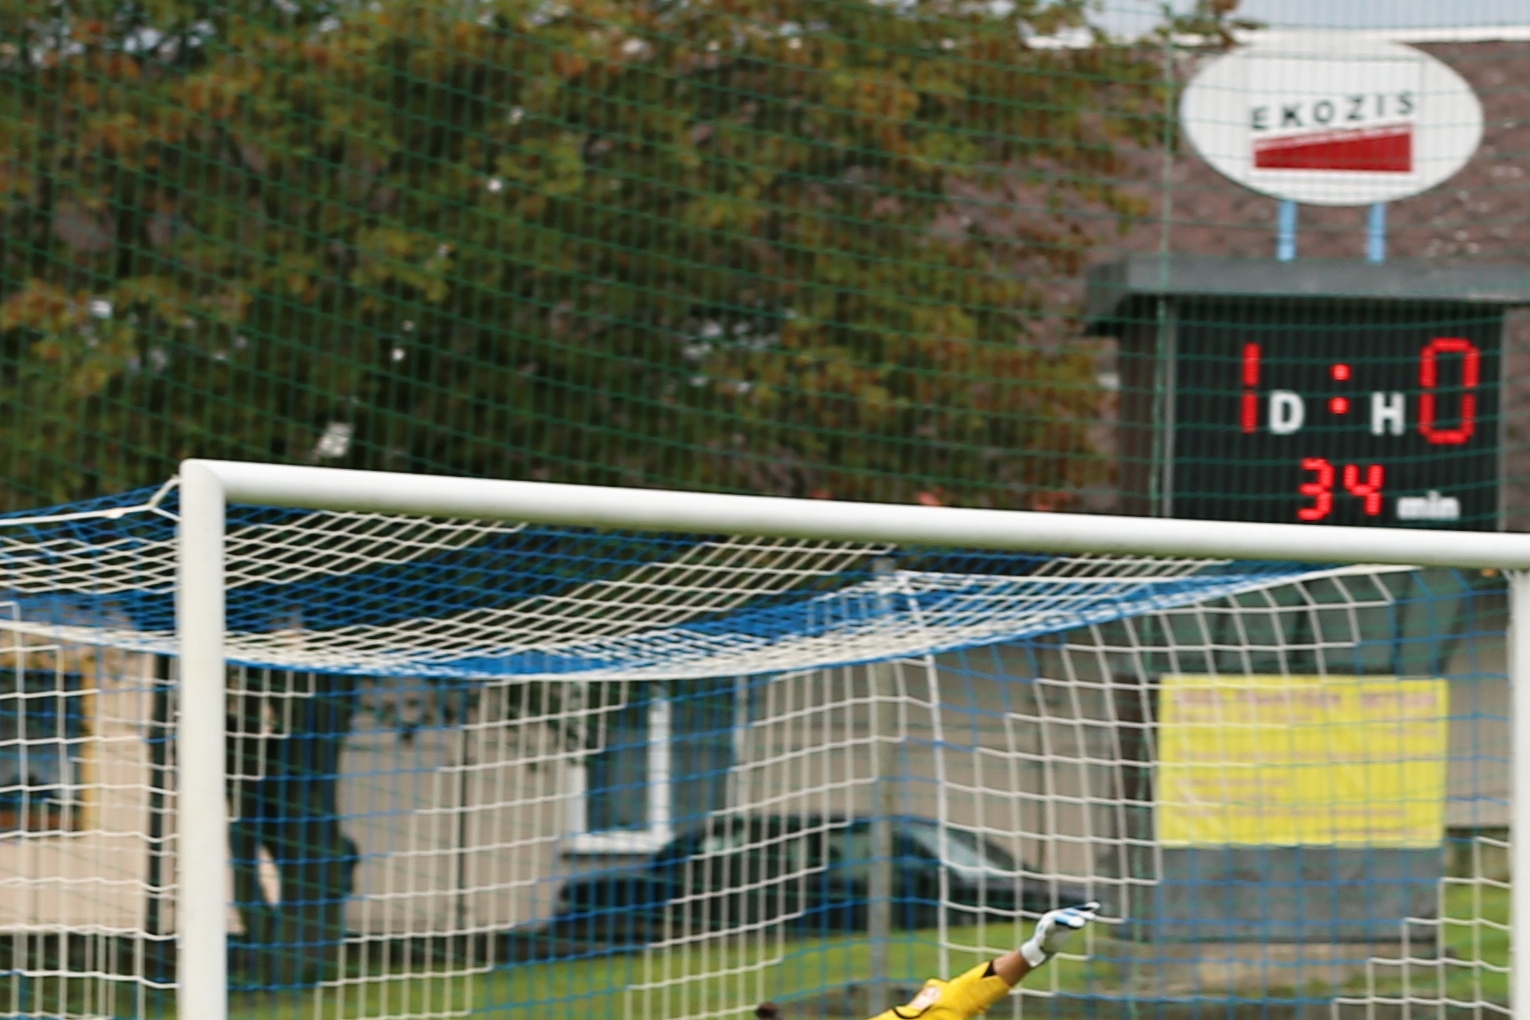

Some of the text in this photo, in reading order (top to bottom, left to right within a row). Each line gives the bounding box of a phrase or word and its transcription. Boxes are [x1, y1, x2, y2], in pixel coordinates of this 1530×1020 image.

[1250, 92, 1415, 130] EKOZIS
[1241, 342, 1261, 434] 1
[1418, 337, 1481, 445] 0
[1268, 390, 1406, 436] D H
[1298, 457, 1385, 521] 34
